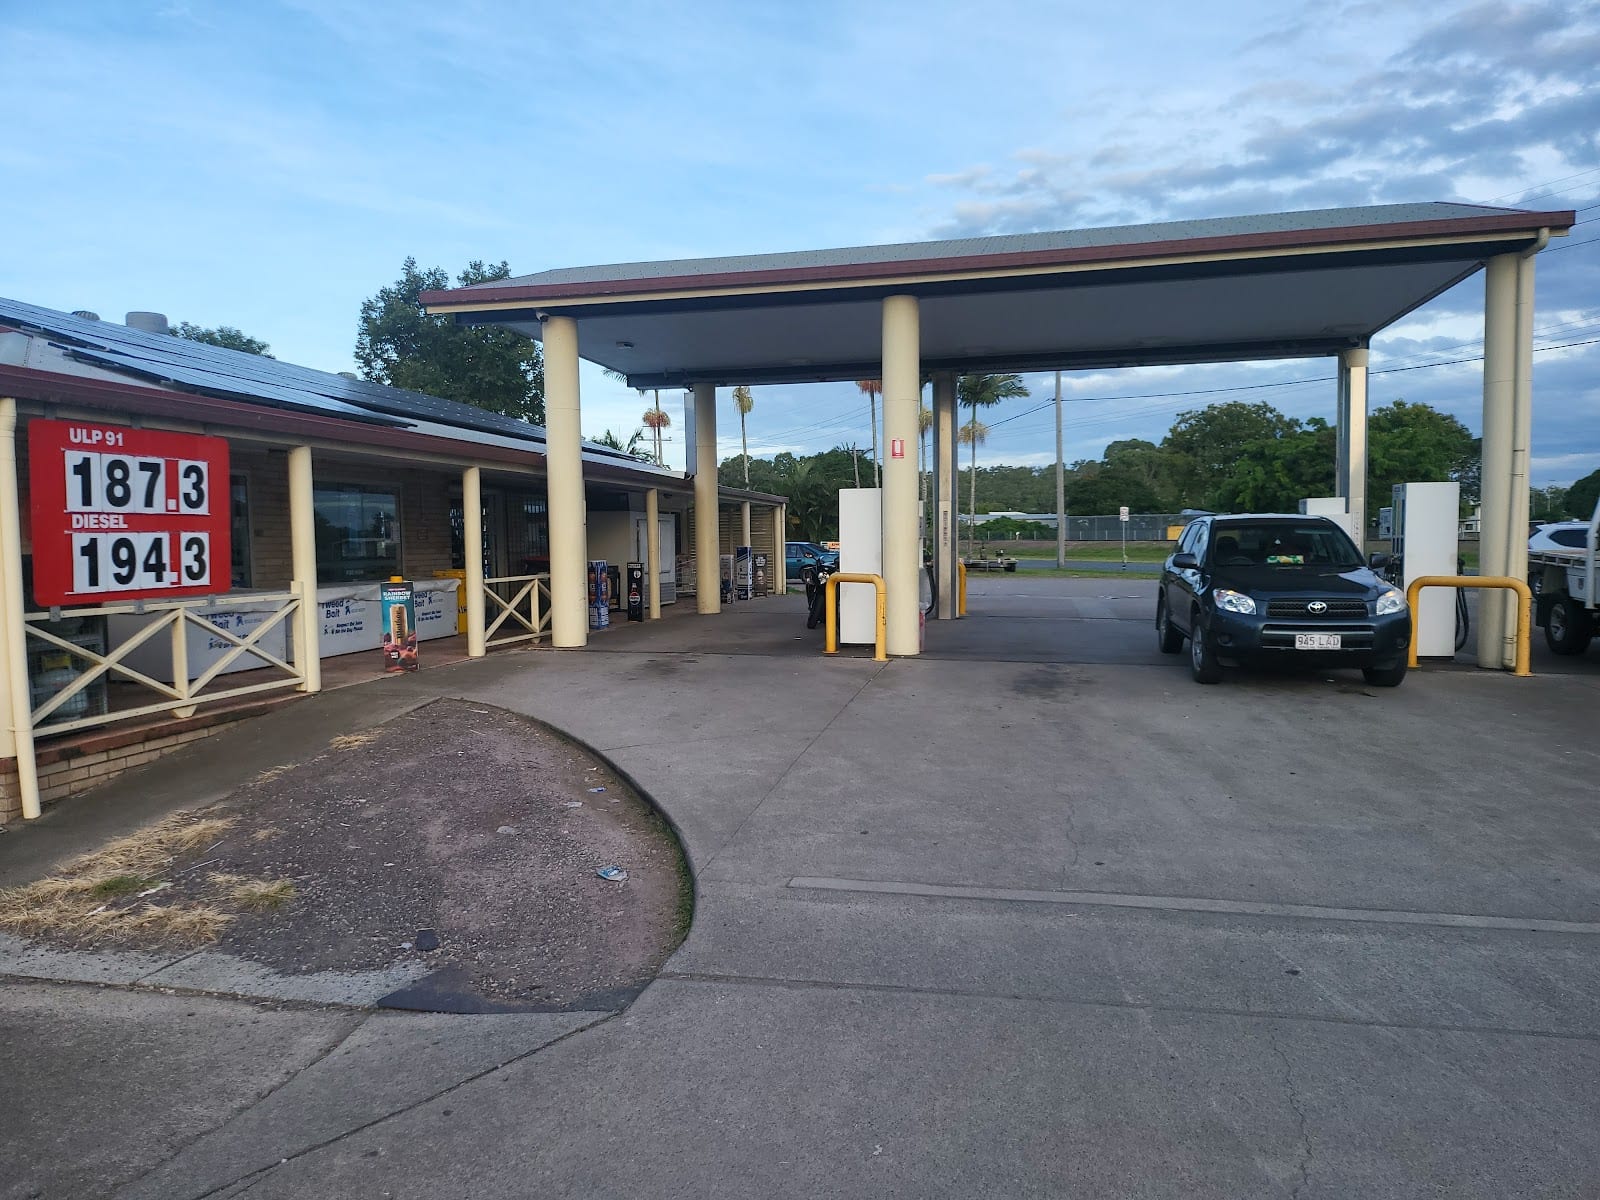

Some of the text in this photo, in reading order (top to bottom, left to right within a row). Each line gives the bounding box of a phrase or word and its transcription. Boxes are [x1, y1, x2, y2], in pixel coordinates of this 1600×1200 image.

[69, 428, 124, 446] ULP 91
[73, 457, 205, 509] 187.3
[72, 514, 128, 529] DIESEL
[80, 536, 207, 587] 194.3
